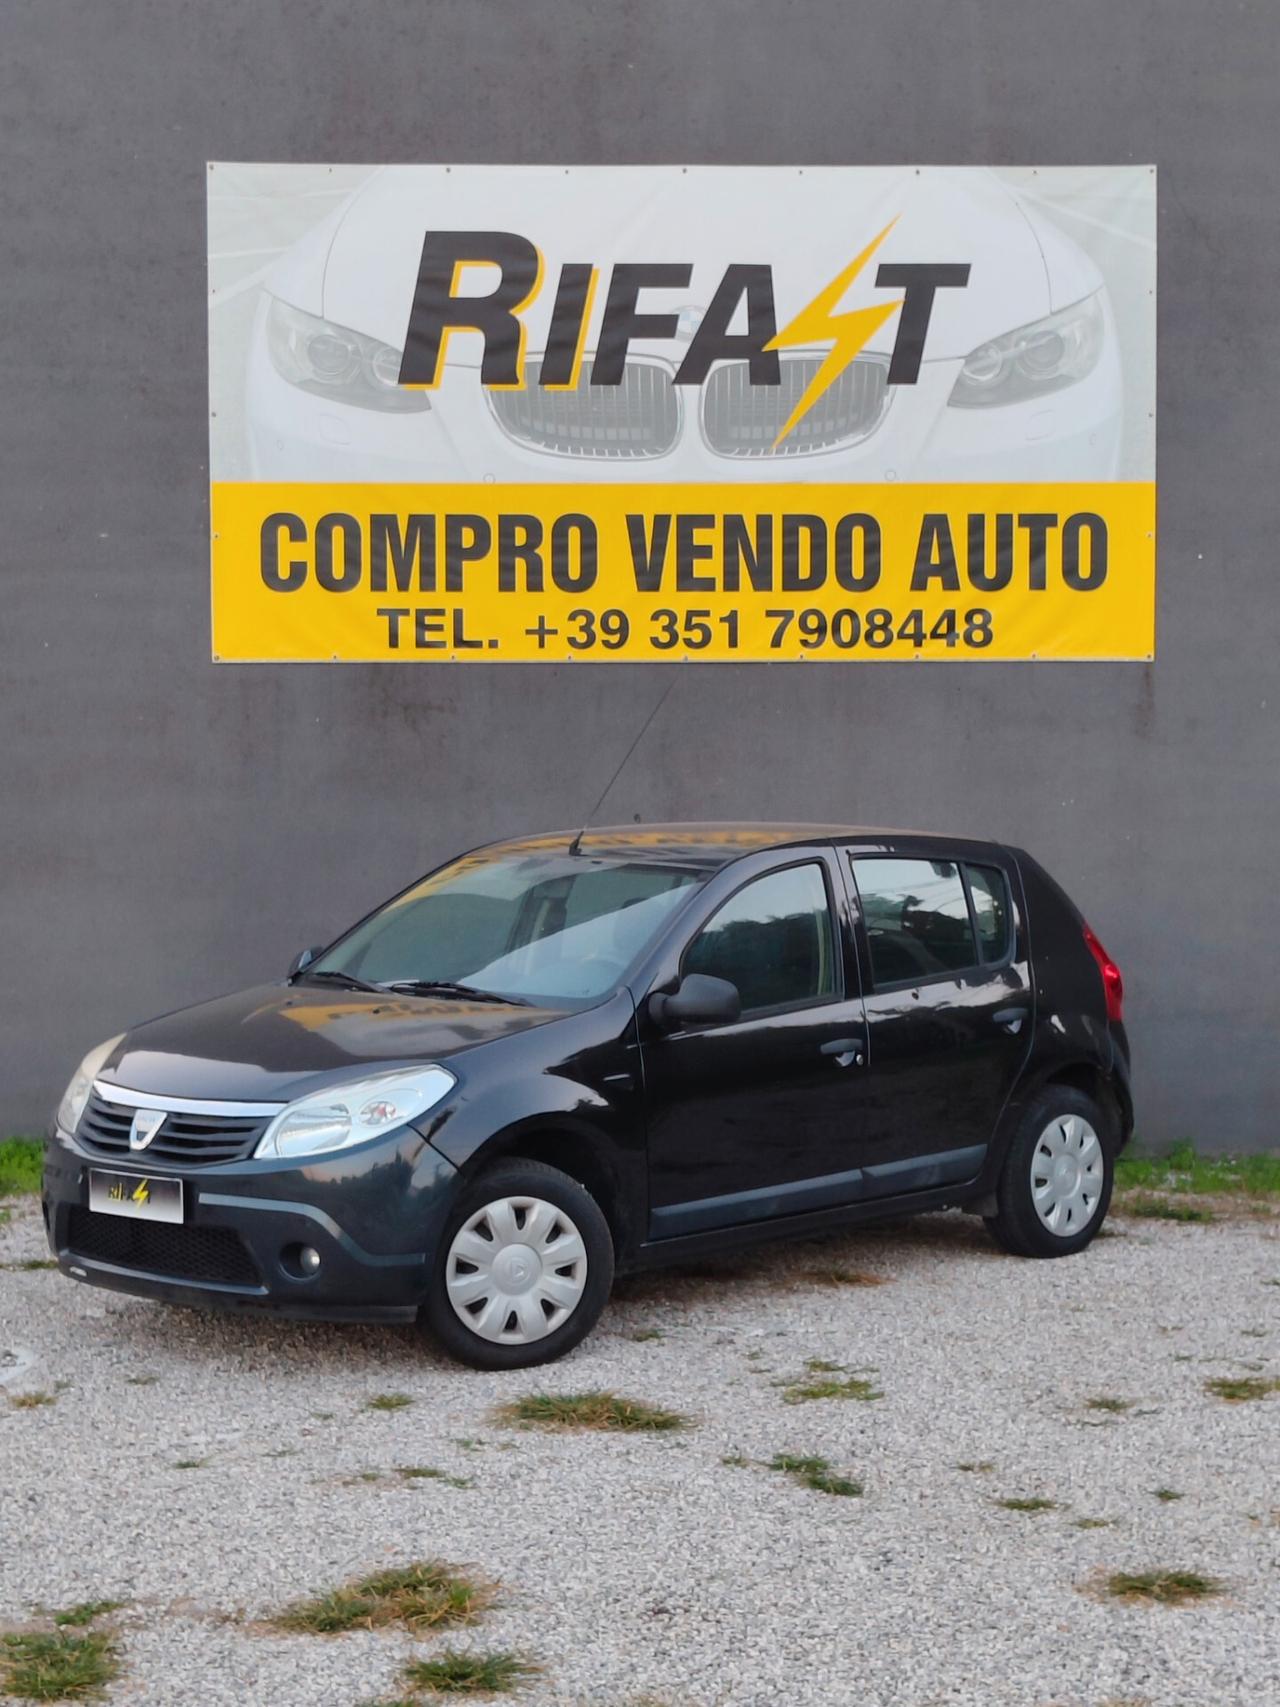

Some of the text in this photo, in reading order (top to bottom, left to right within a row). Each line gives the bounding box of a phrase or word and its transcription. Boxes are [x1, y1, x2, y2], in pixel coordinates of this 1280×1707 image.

[260, 512, 1108, 593] COMPRO VENDO AUTO
[376, 608, 993, 650] TEL. +39 351 7908448
